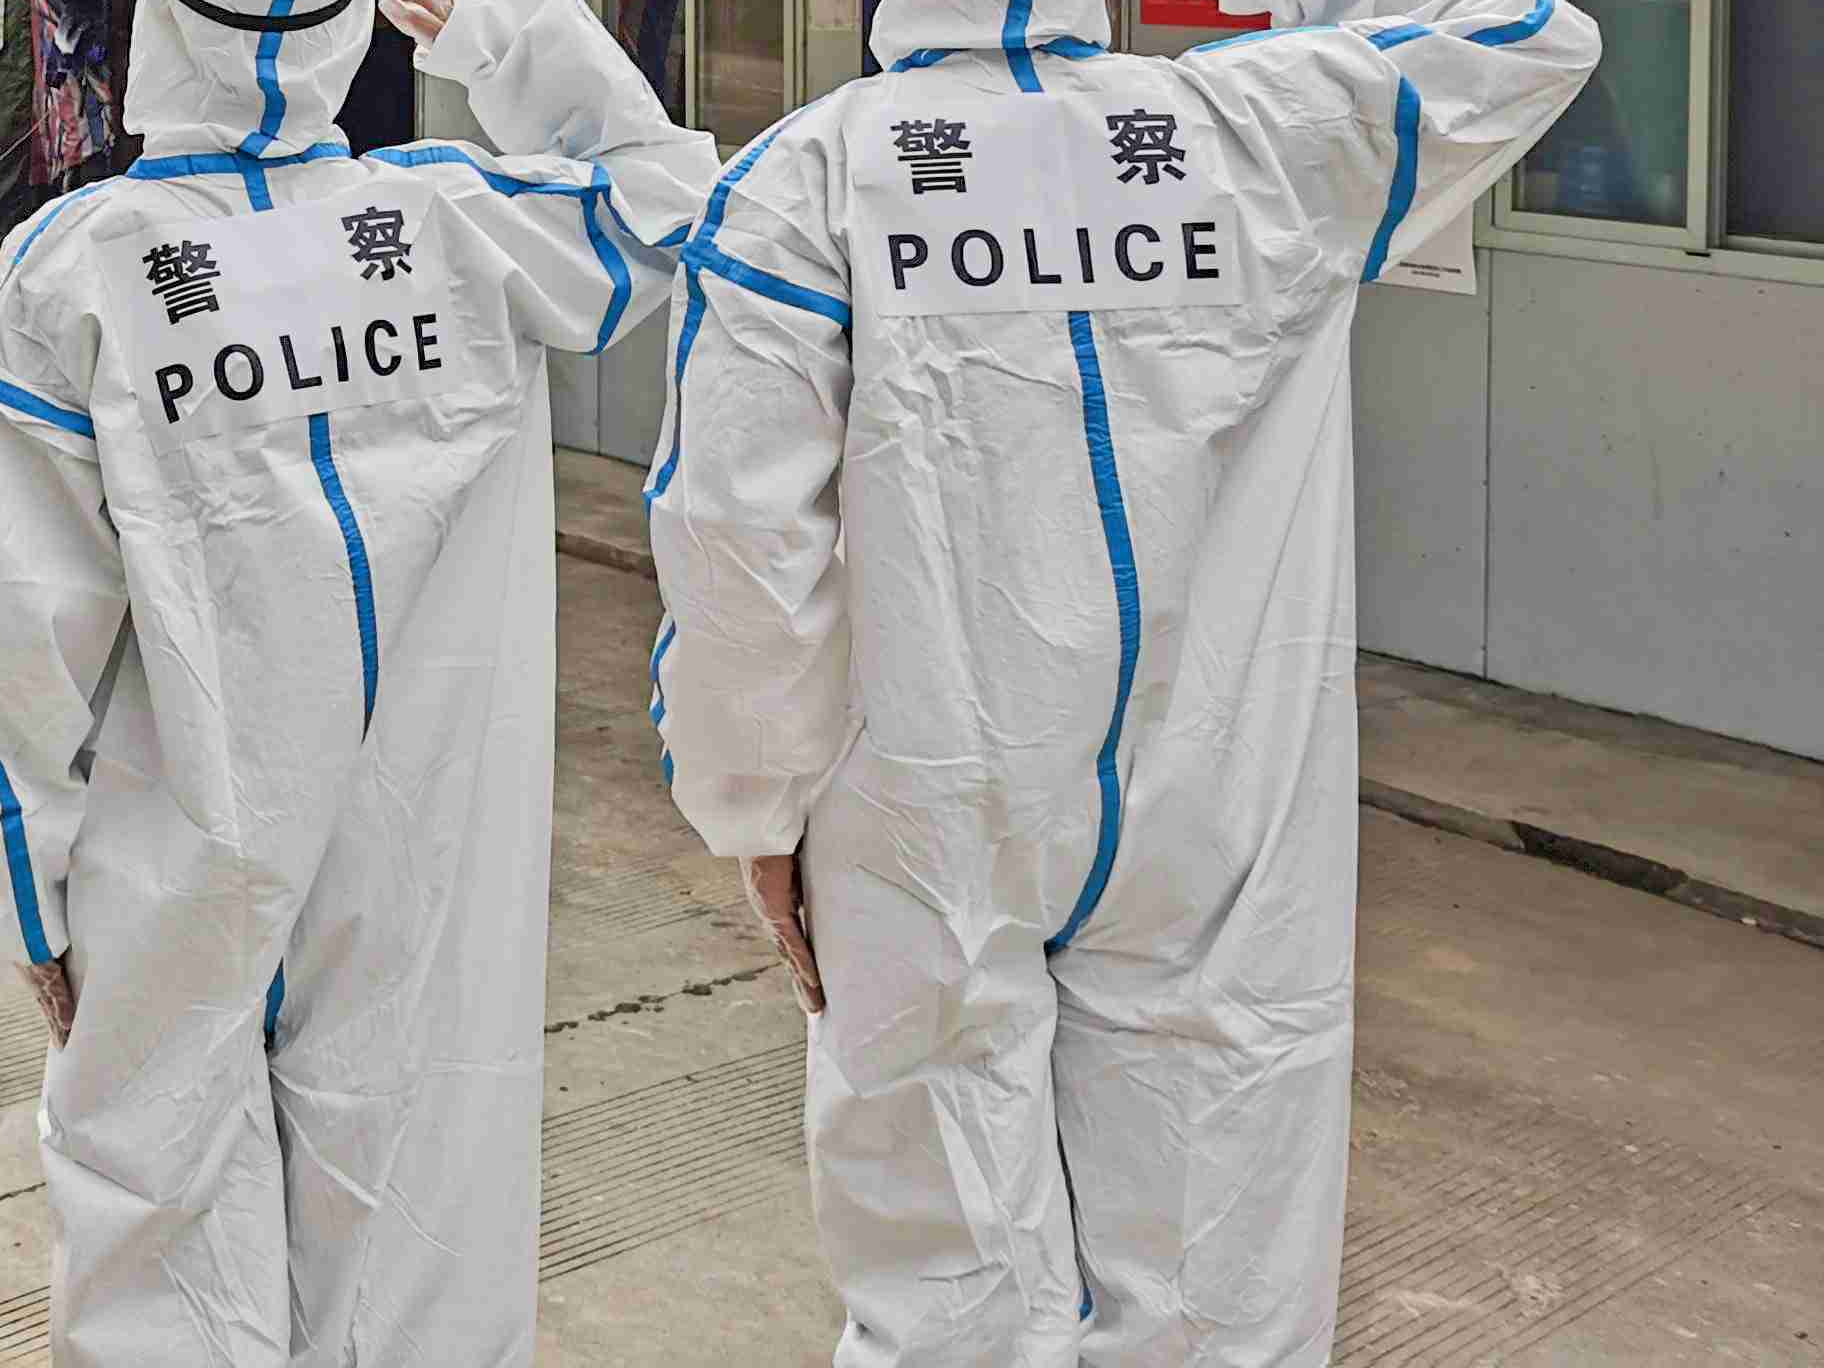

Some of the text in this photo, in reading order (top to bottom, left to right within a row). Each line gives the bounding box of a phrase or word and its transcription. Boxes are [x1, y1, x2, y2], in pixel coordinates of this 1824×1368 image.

[889, 108, 1187, 195] 警察
[142, 206, 413, 325] 警察
[887, 221, 1220, 290] POLICE
[154, 313, 442, 424] POLICE
